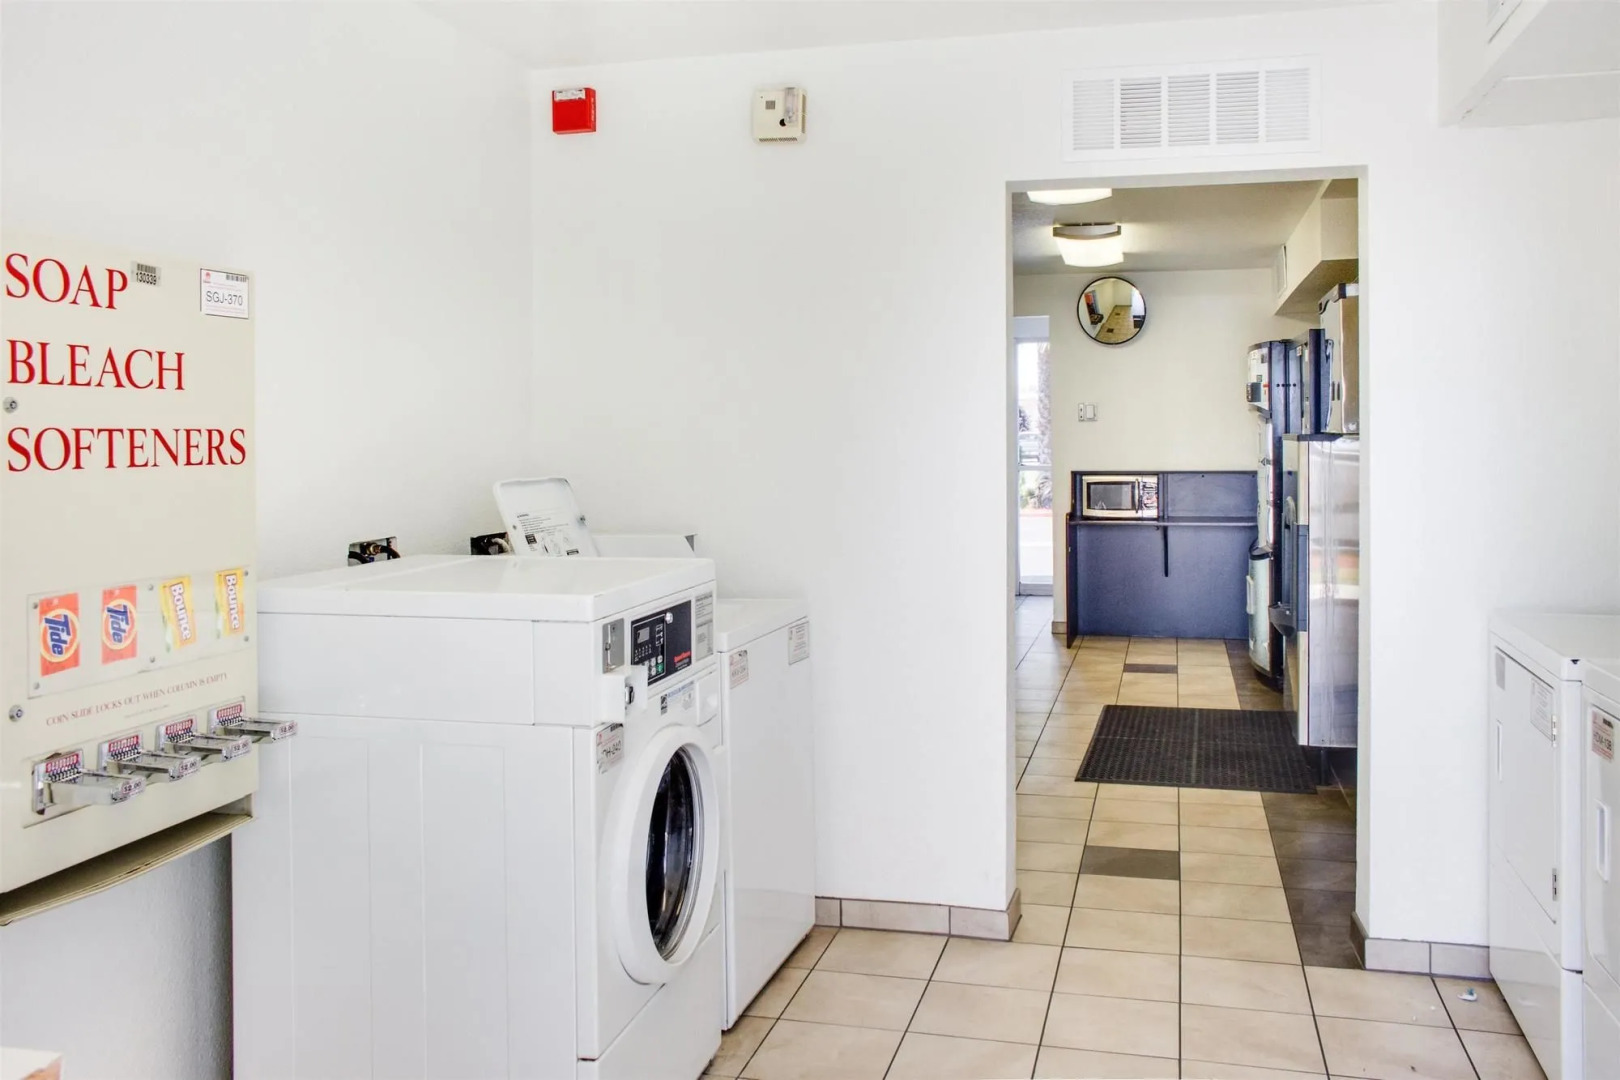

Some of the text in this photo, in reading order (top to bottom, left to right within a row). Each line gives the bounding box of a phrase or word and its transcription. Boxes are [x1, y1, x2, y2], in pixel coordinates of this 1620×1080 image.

[5, 253, 128, 310] SOAP
[136, 272, 157, 286] 130339
[206, 290, 243, 306] SGJ-370
[7, 339, 186, 391] BLEACH
[7, 427, 247, 472] SOFTENERS
[106, 603, 130, 643] Tide
[170, 583, 192, 640] Bounce
[225, 575, 240, 630] Bounce
[44, 613, 71, 655] Tide
[46, 714, 68, 726] COIN
[71, 706, 92, 718] SLIDE
[95, 699, 122, 713] LOCKS
[124, 694, 141, 706] OUT
[142, 688, 166, 700] WHEN
[206, 672, 228, 685] EMPTY
